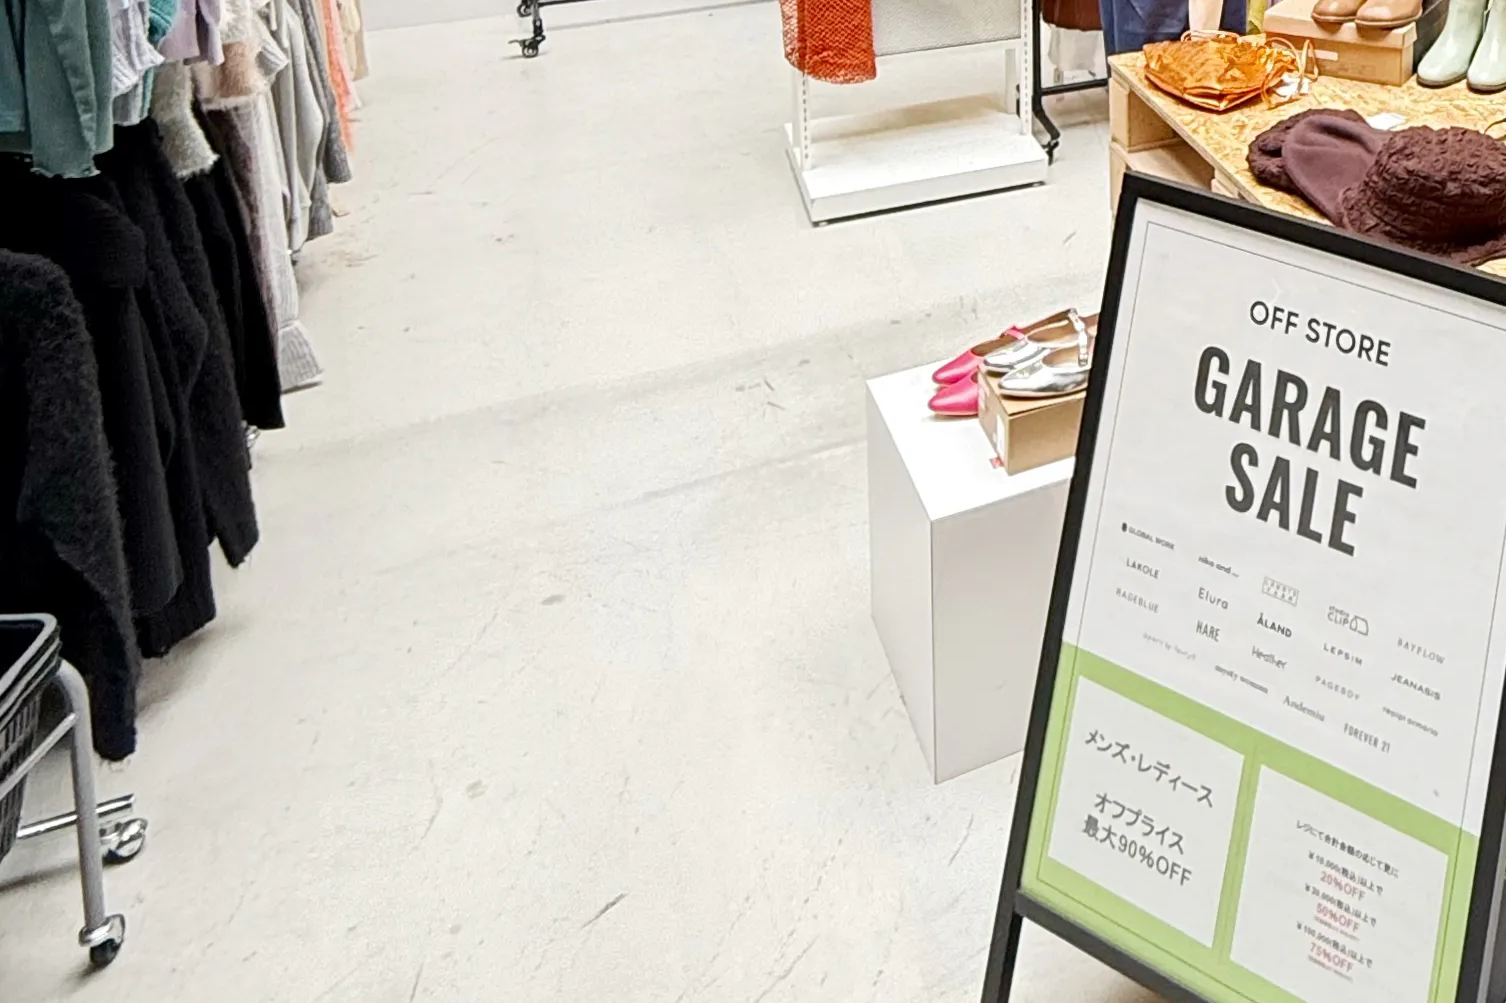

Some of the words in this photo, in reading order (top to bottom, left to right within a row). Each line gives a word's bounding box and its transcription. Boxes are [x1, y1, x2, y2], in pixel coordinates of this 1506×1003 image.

[1250, 301, 1299, 334] OFF
[1305, 318, 1391, 366] STORE
[1194, 346, 1426, 489] GARAGE
[1225, 442, 1364, 557] SALE
[1128, 526, 1154, 543] GLOBAL
[1155, 537, 1175, 550] WORK
[1126, 557, 1160, 579] LAKOLE
[1115, 587, 1159, 614] RAGEBLUE
[1198, 587, 1229, 610] Elura
[1195, 619, 1221, 642] HARE
[1256, 612, 1293, 639] ÅLAND
[1327, 612, 1350, 626] CLIP
[1251, 645, 1288, 670] Heather
[1323, 642, 1363, 666] LEPSIM
[1398, 637, 1445, 665] BAYFLOW
[1315, 676, 1361, 701] PAGEBOY
[1390, 673, 1441, 700] JEANASIS
[1283, 695, 1326, 722] Andemiu
[1343, 722, 1379, 749] FOREVER
[1381, 741, 1391, 754] 21
[1085, 729, 1213, 808] メンズ・レディース
[1094, 792, 1184, 855] オフプライス
[1082, 813, 1192, 886] 最大90%OFF
[1320, 870, 1366, 901] 20%OFF
[1309, 941, 1354, 973] 75%OFF
